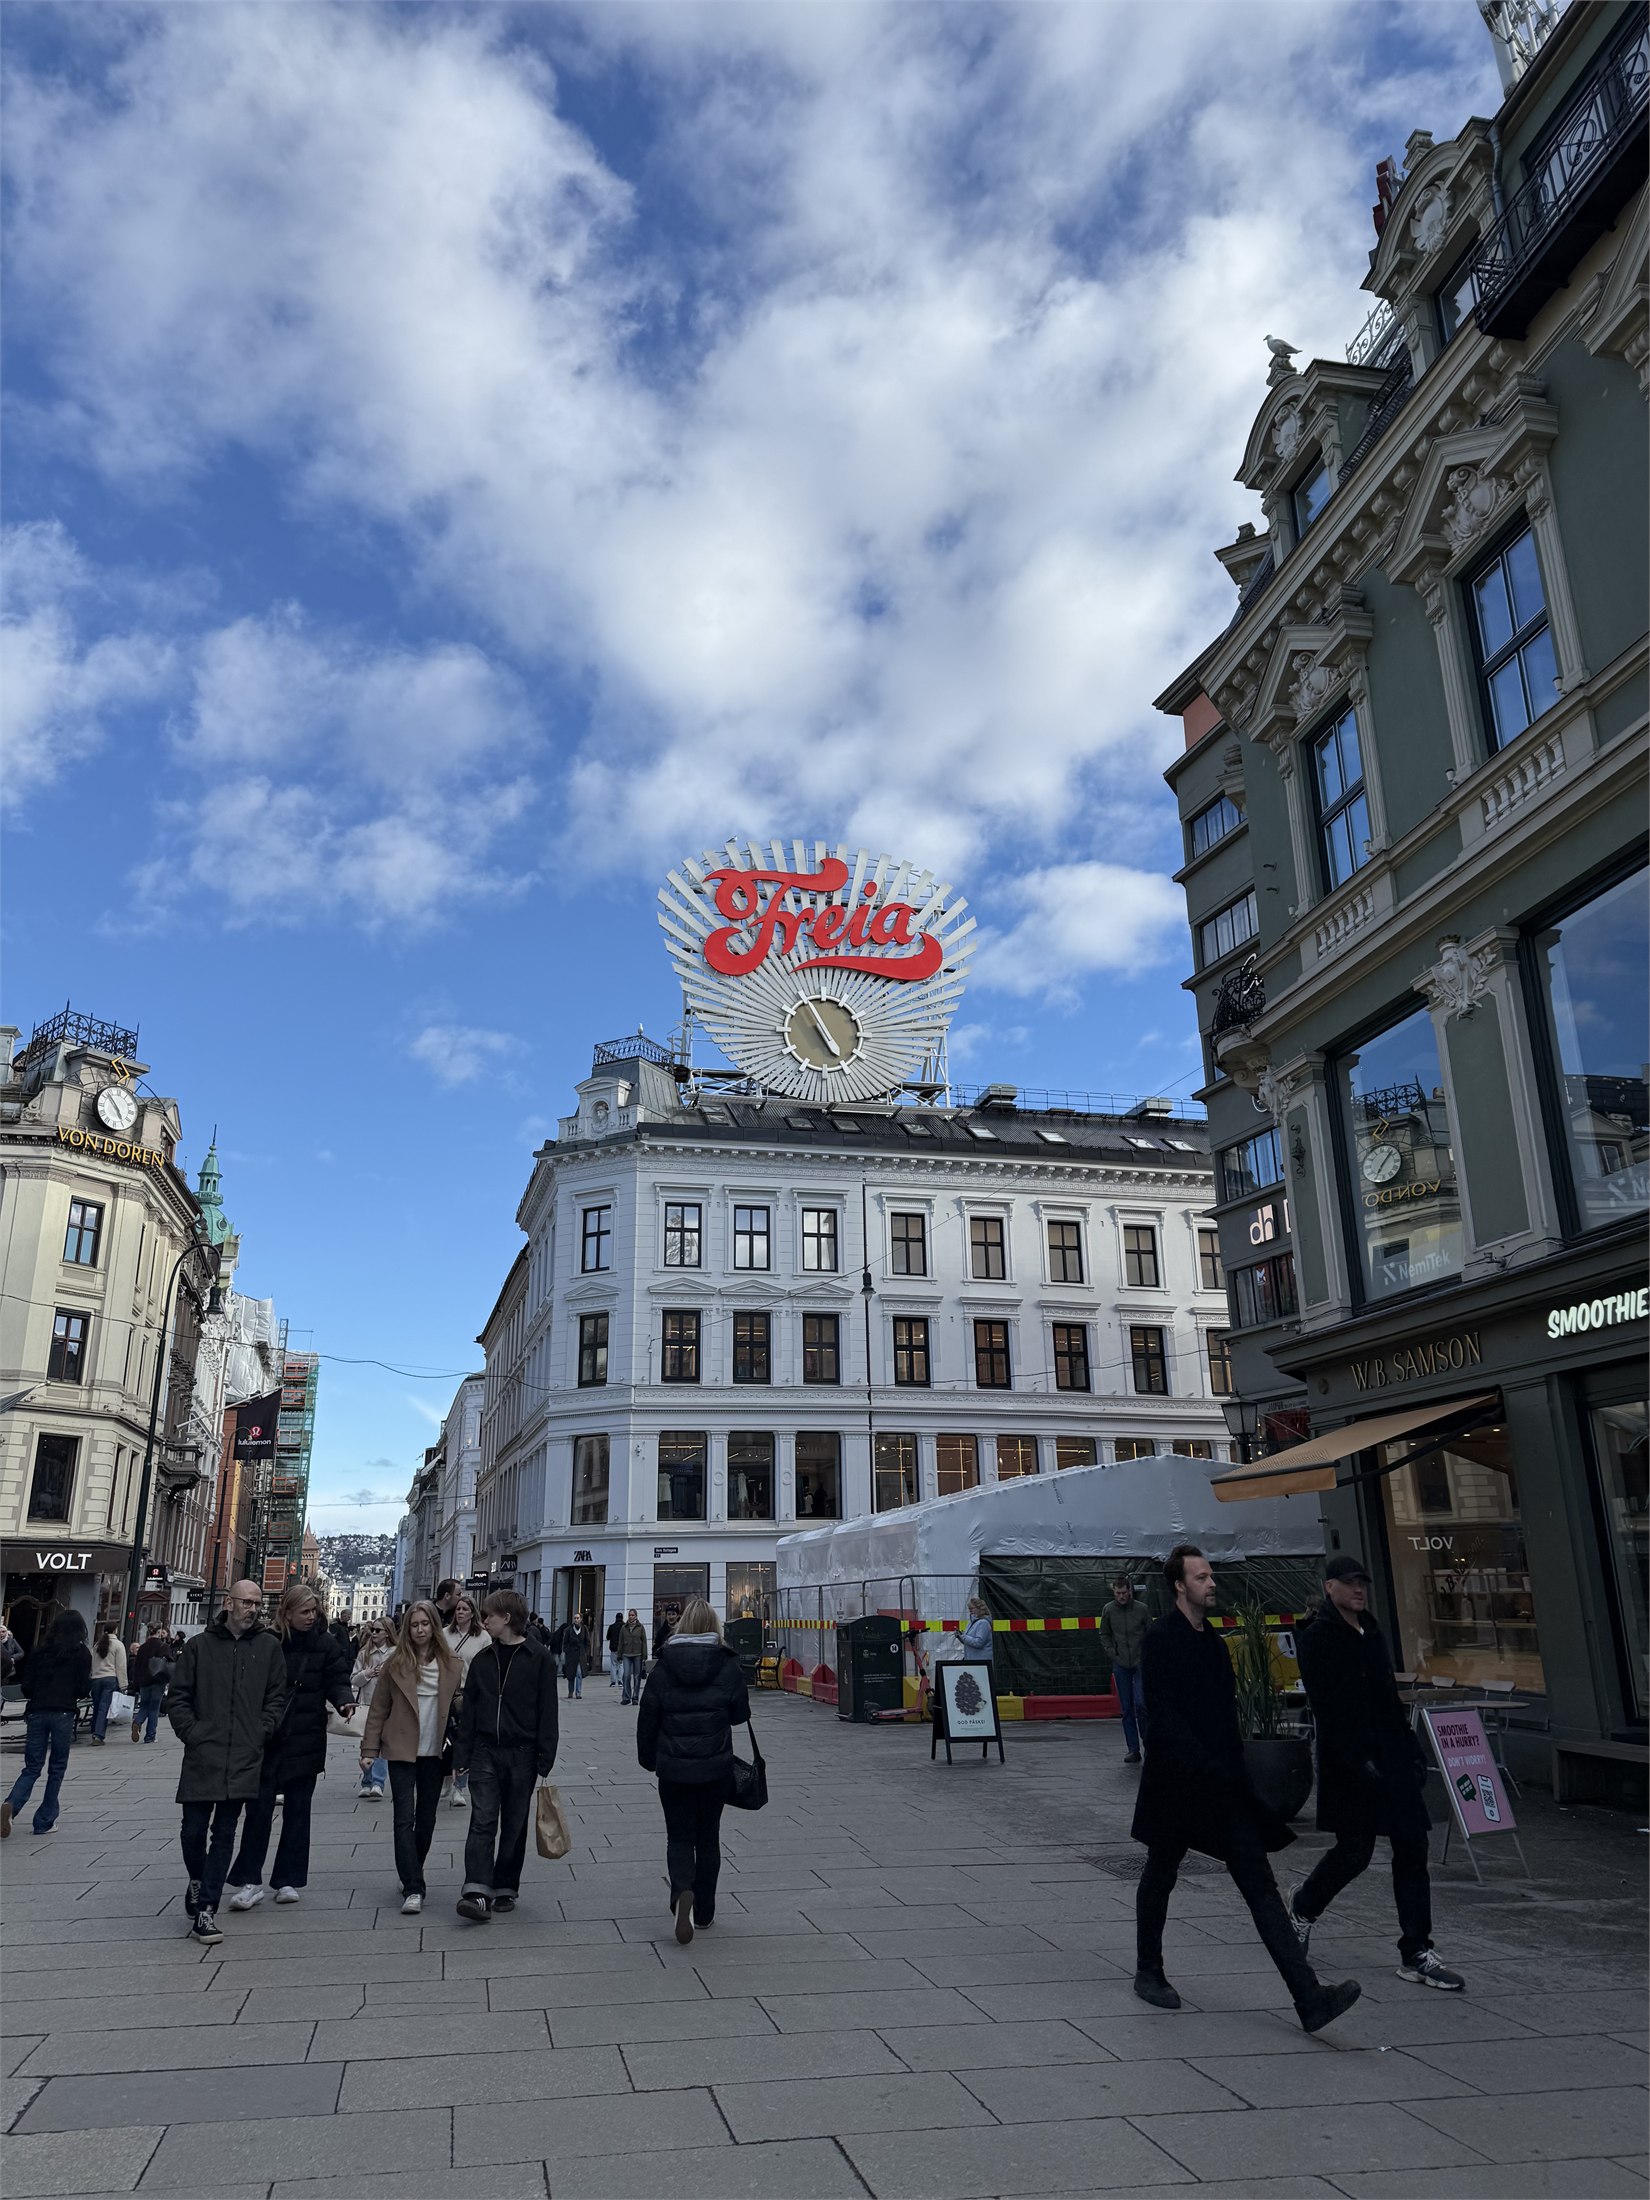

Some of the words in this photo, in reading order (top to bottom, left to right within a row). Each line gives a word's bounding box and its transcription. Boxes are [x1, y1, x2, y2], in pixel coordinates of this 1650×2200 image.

[702, 857, 943, 980] Freia
[57, 1125, 98, 1151] VON
[103, 1138, 164, 1168] DOREN
[1393, 1332, 1482, 1382] SAMSON
[35, 1552, 93, 1570] VOLT
[573, 1550, 593, 1562] ZARA
[1437, 1724, 1469, 1736] SMOOTHIE
[1441, 1737, 1450, 1749] IN
[1450, 1737, 1456, 1748] A
[1454, 1735, 1480, 1748] HURRY?
[1447, 1756, 1465, 1767] DON'T
[1464, 1754, 1487, 1765] WORRY!
